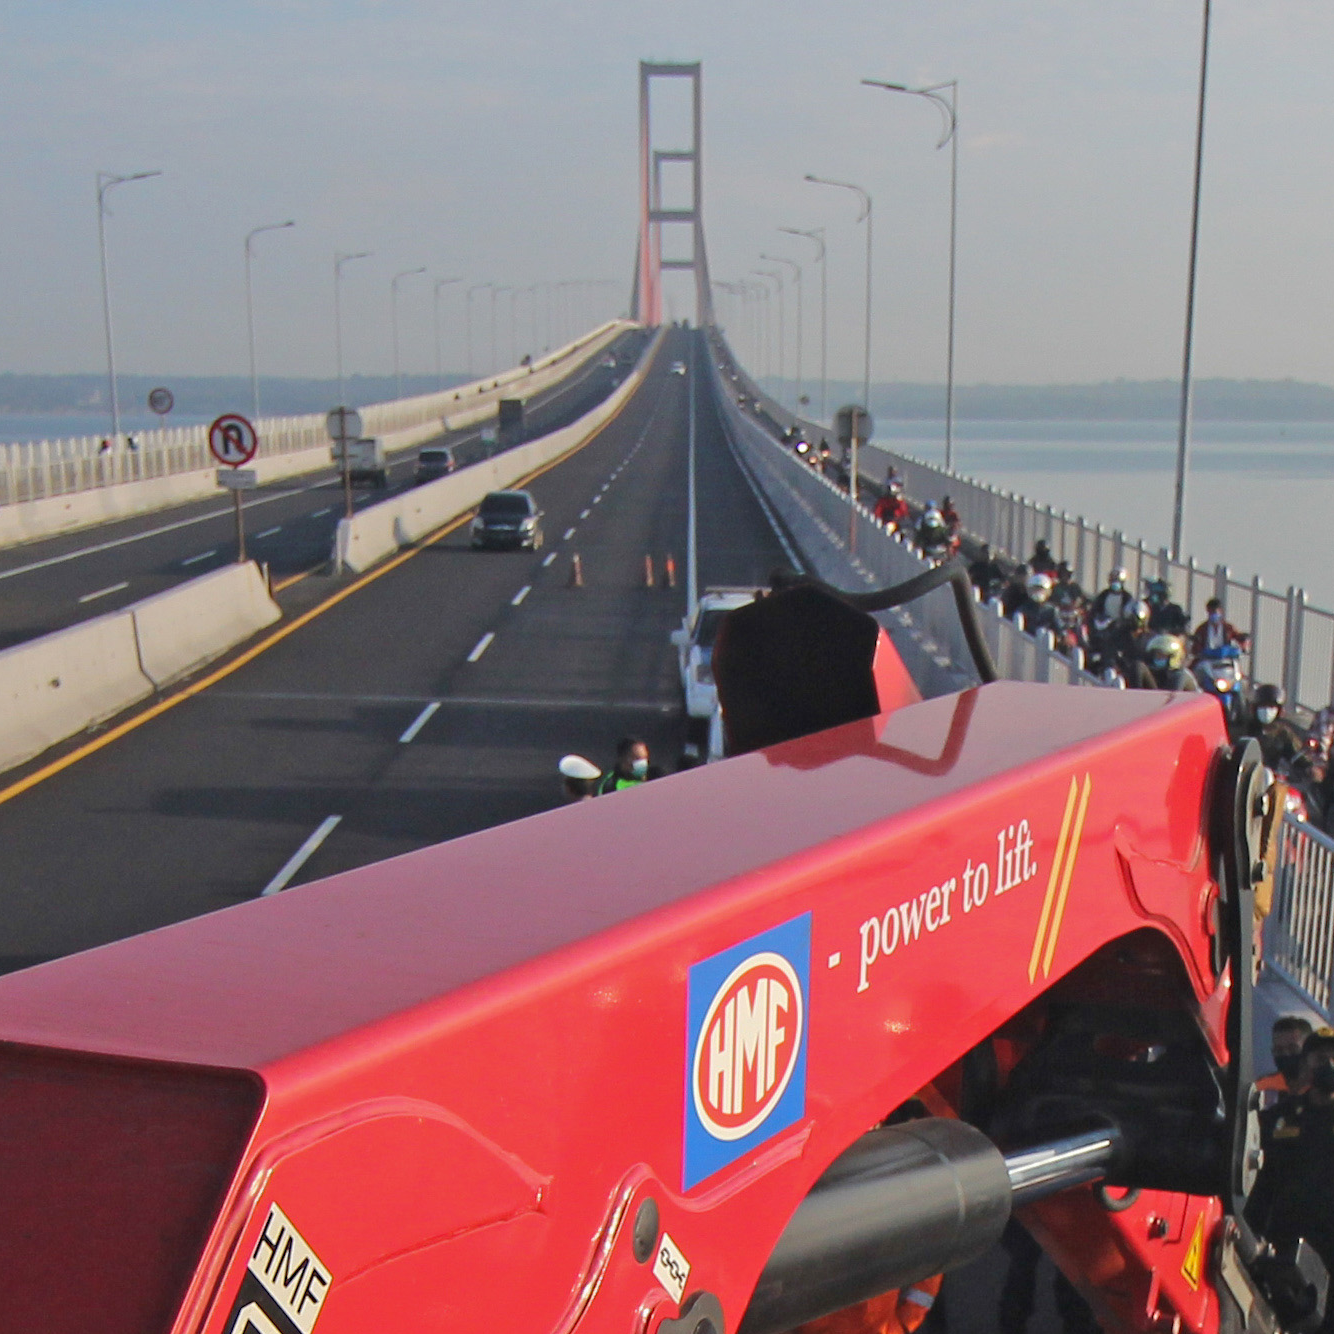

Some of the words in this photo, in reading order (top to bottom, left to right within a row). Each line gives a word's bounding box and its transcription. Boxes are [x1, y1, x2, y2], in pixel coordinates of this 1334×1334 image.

[856, 878, 957, 992] power
[962, 859, 988, 912] to
[995, 819, 1037, 896] lift.
[709, 978, 788, 1115] HMF
[253, 1212, 328, 1315] HMF
